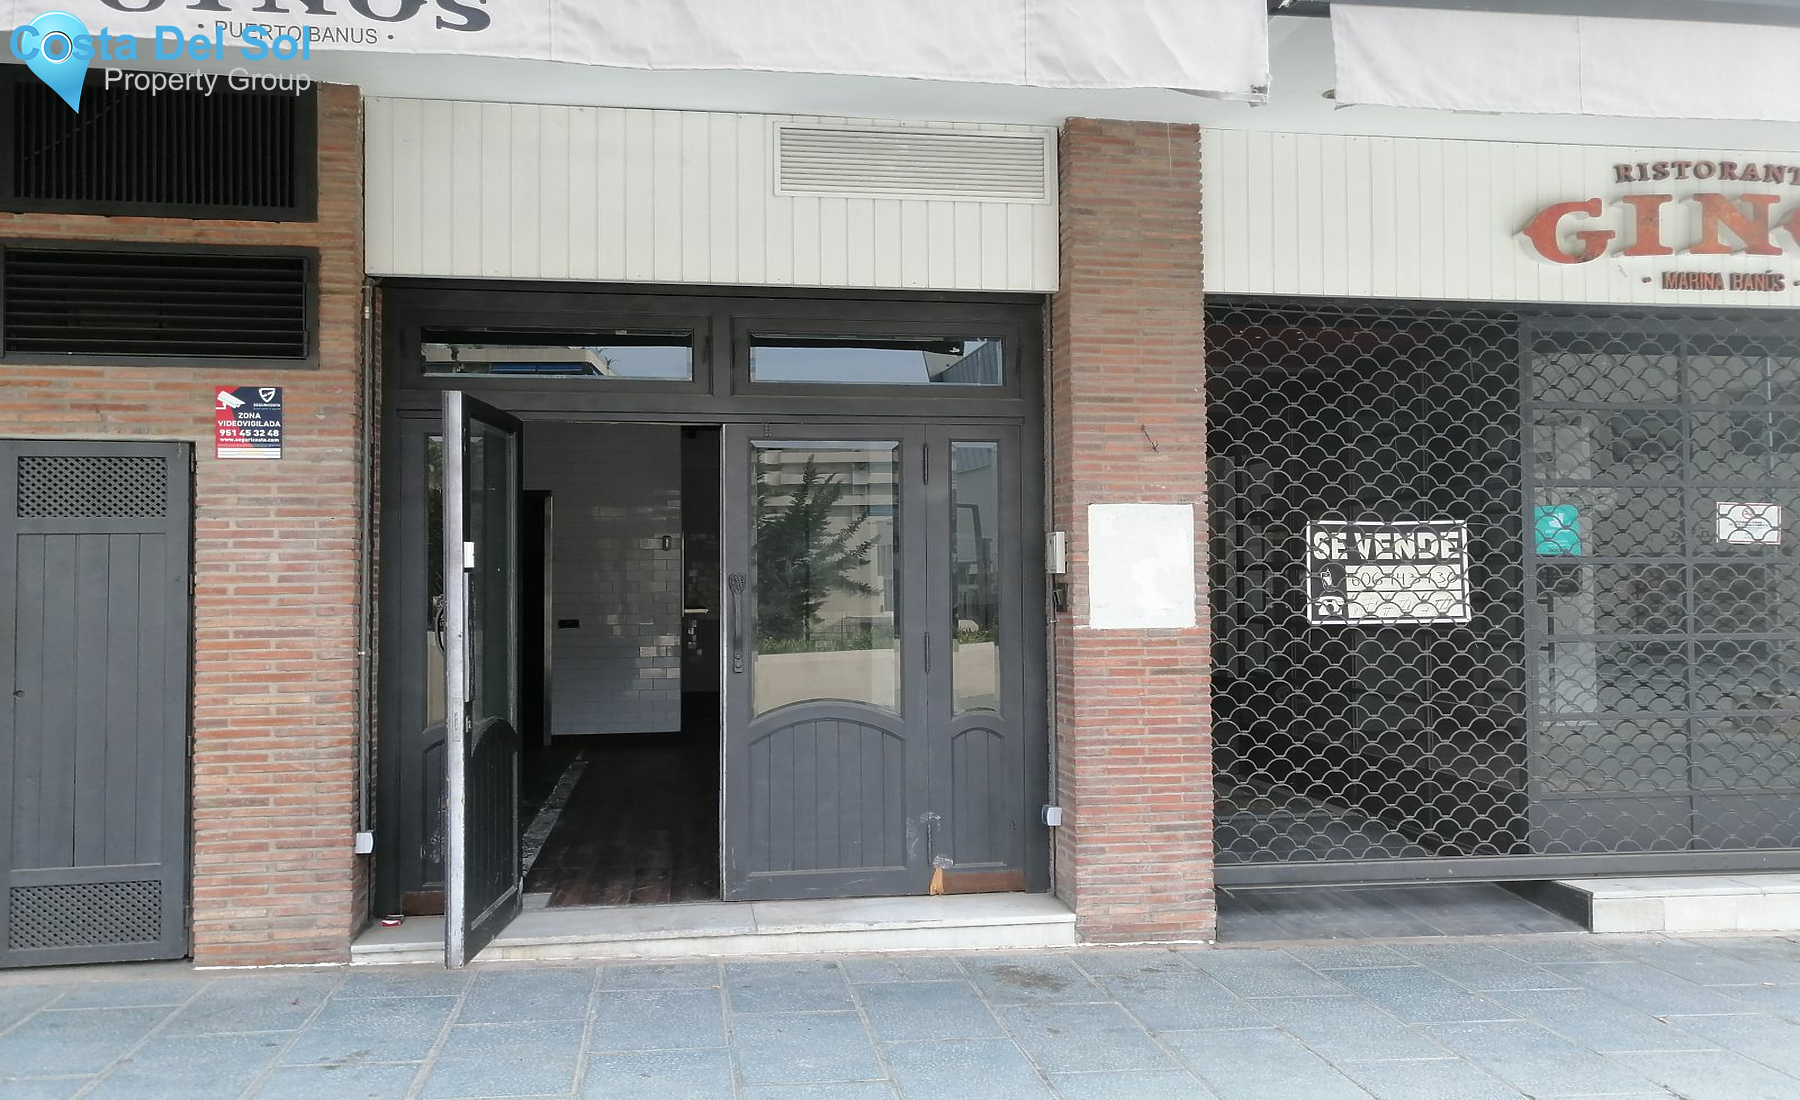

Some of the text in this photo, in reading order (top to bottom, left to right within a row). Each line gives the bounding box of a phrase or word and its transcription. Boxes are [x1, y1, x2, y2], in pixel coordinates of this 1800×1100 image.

[308, 26, 378, 45] BANUS
[1523, 192, 1800, 264] GIN
[1662, 271, 1725, 291] MARINA
[219, 429, 280, 437] 951 45 32 48
[1313, 531, 1461, 560] SE VENDE
